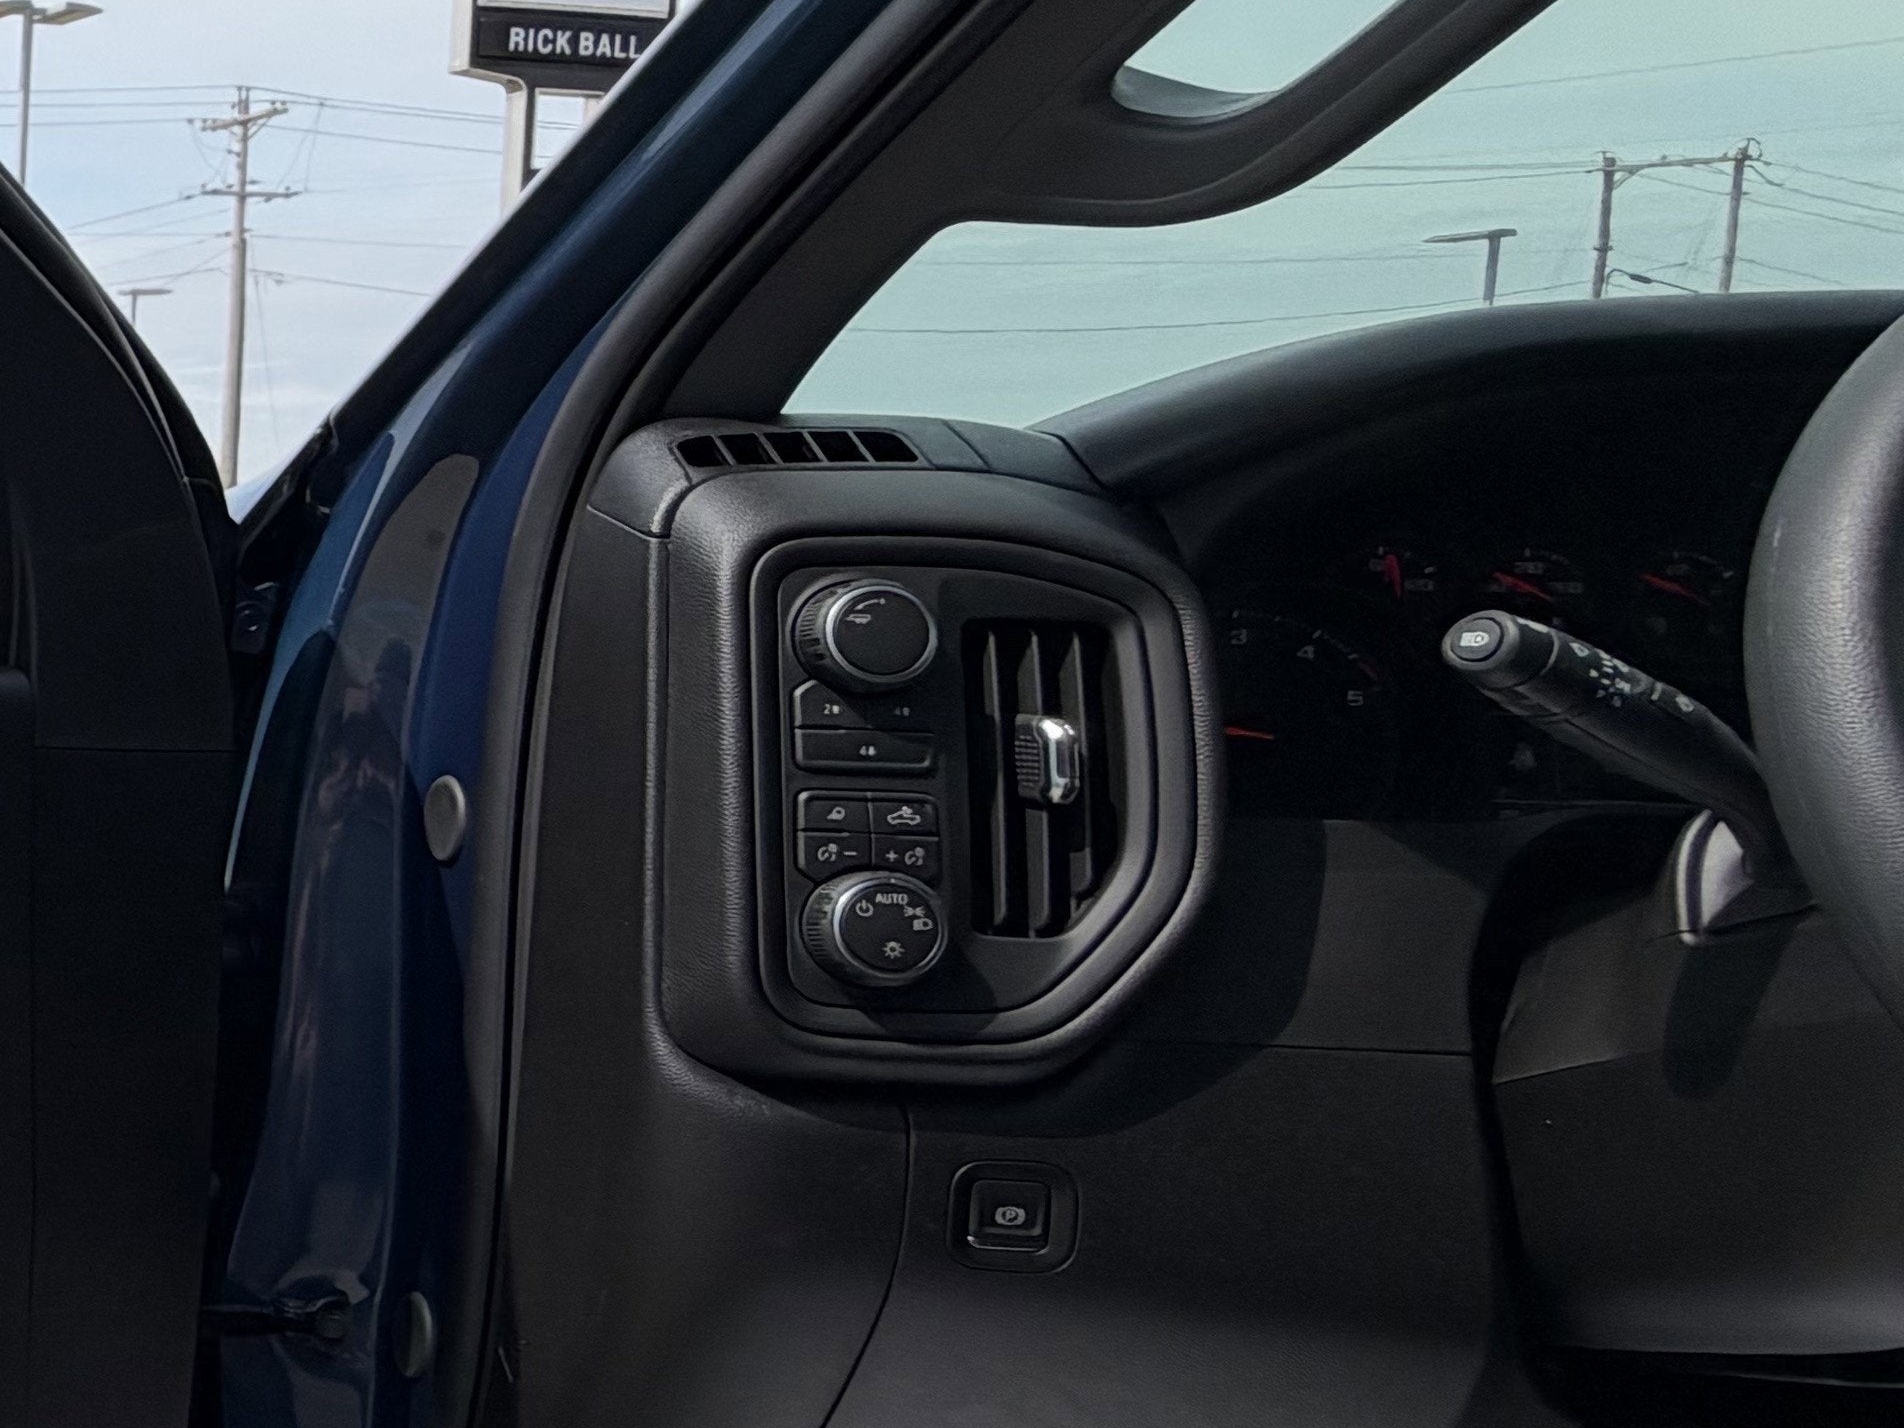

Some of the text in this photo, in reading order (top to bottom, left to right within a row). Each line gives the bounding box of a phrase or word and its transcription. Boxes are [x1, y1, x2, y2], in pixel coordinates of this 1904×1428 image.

[508, 26, 643, 59] RICK BALL
[1295, 644, 1316, 661] 4
[1346, 689, 1365, 707] 5
[875, 893, 909, 905] AUTO
